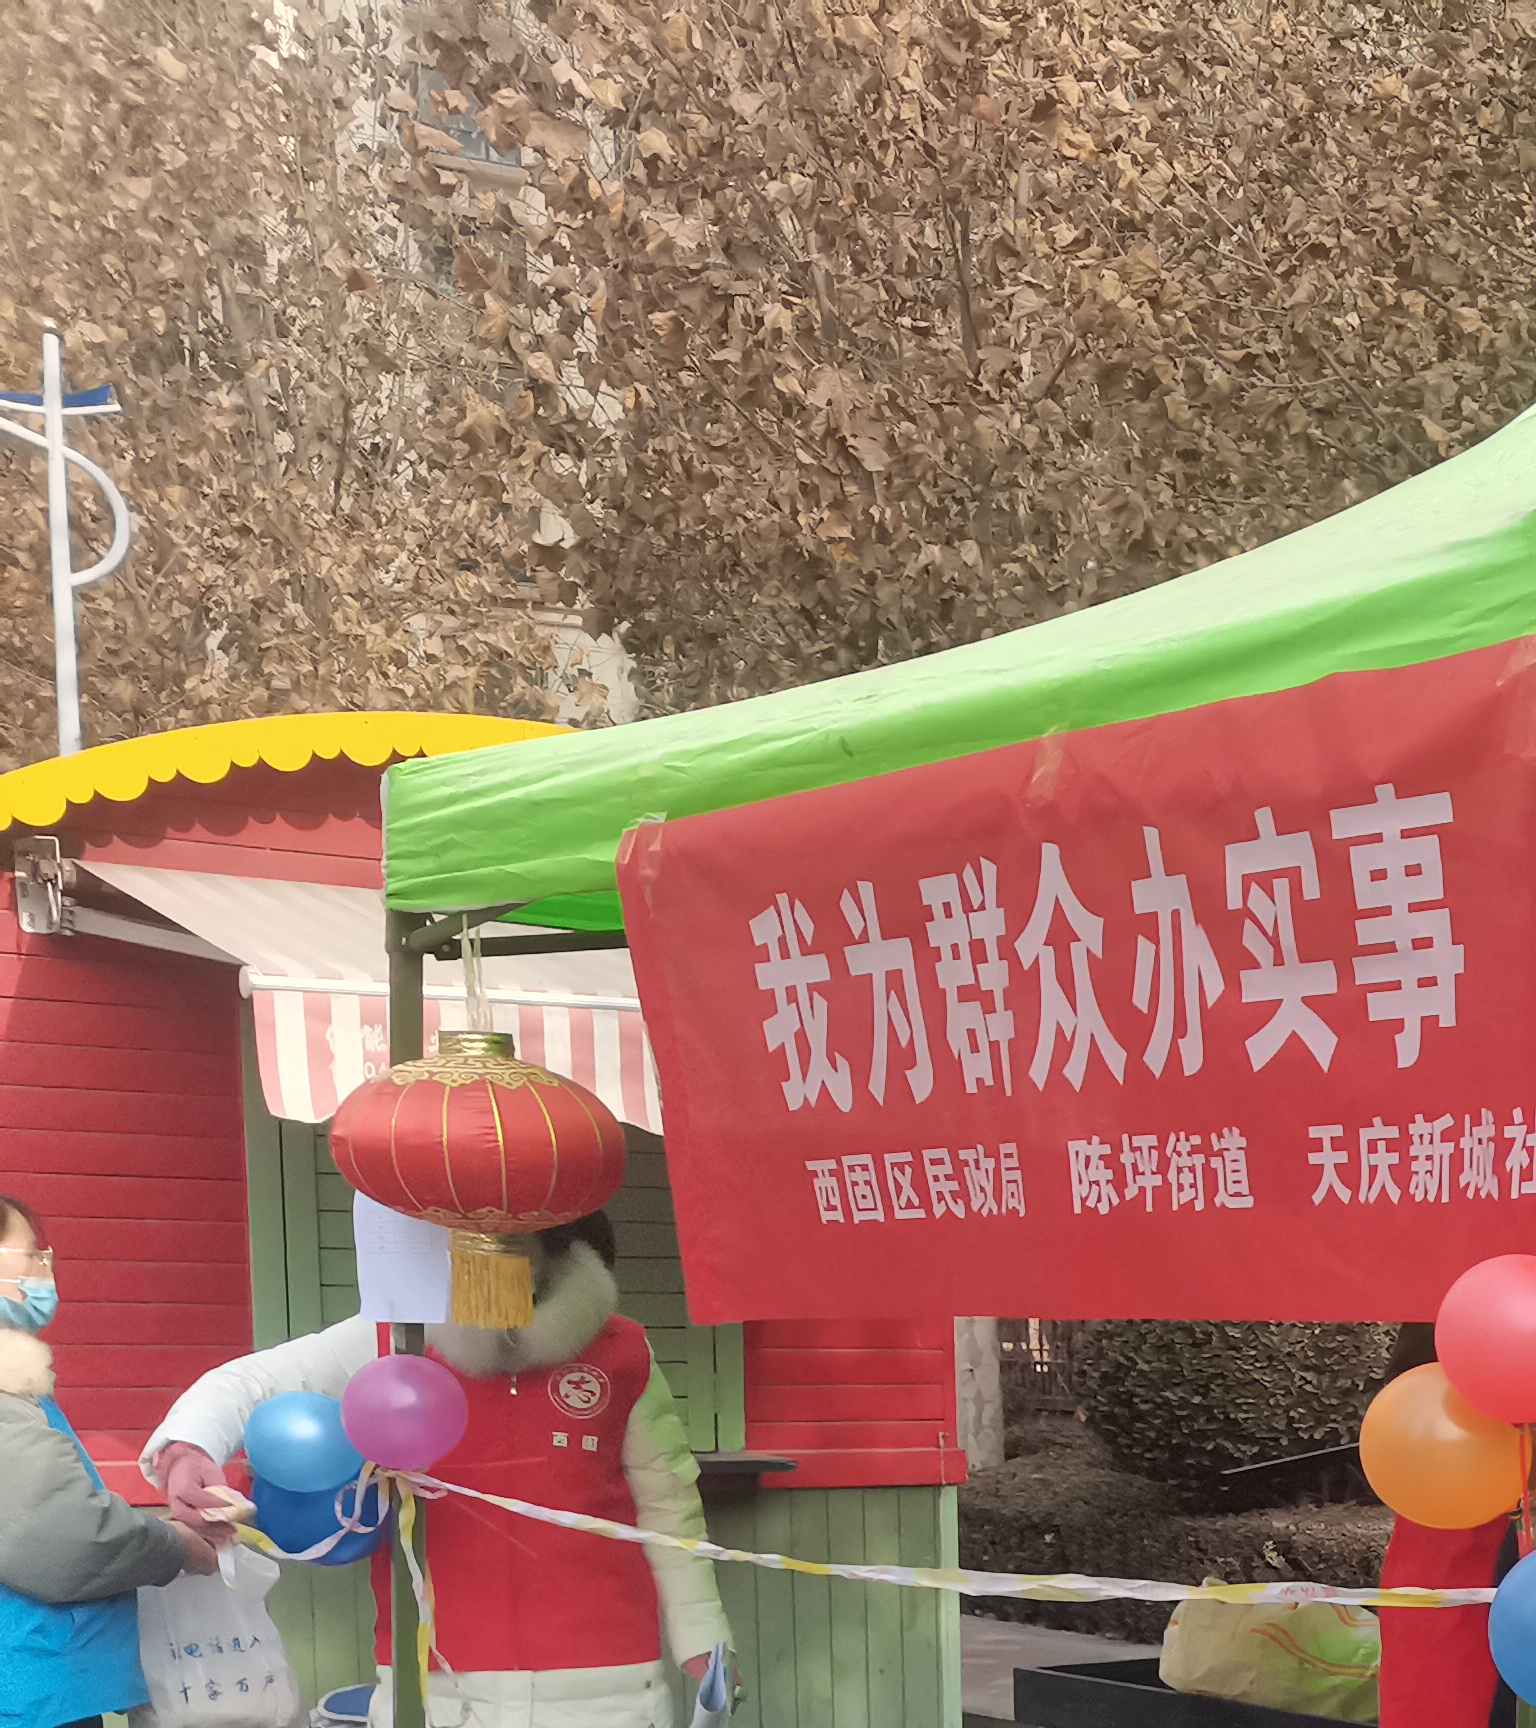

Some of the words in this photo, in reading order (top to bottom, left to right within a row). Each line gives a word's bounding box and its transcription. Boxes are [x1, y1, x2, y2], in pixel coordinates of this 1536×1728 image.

[748, 782, 1464, 1112] 我为群众办实事
[805, 1142, 1026, 1224] 西固区民政局
[1067, 1126, 1254, 1215] 陈坪街道
